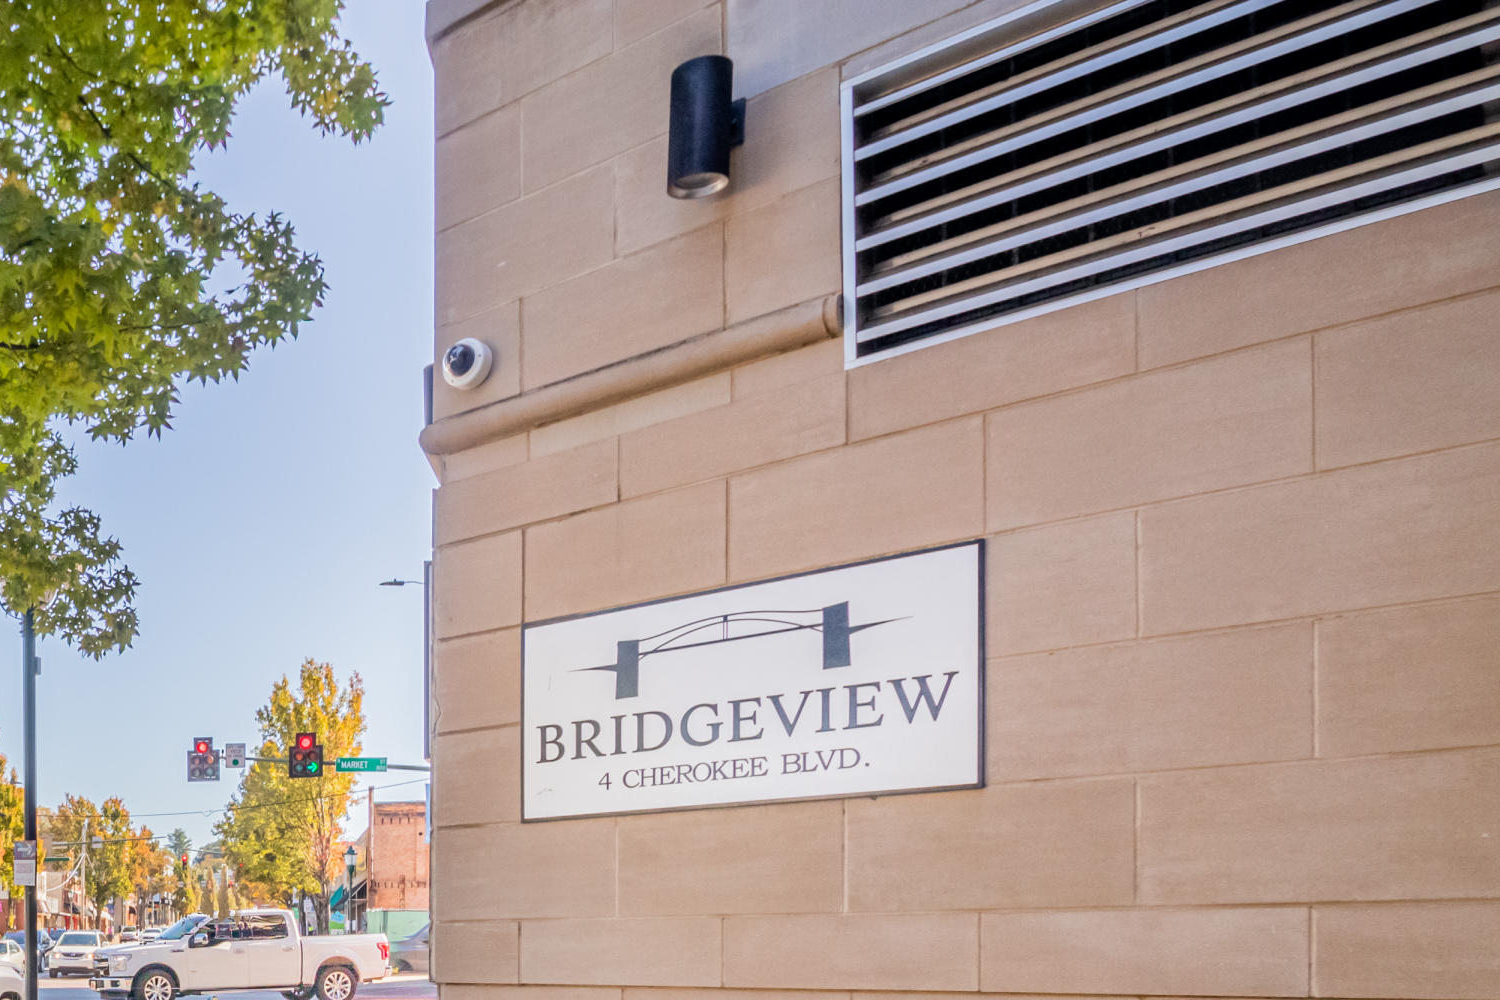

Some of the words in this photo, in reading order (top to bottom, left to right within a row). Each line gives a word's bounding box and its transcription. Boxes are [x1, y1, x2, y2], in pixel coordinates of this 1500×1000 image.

[536, 671, 960, 764] BRIDGEVIEW
[340, 760, 368, 769] MARKET
[599, 772, 612, 790] 4
[622, 756, 769, 789] CHEROKEE
[780, 747, 871, 775] BLVD.
